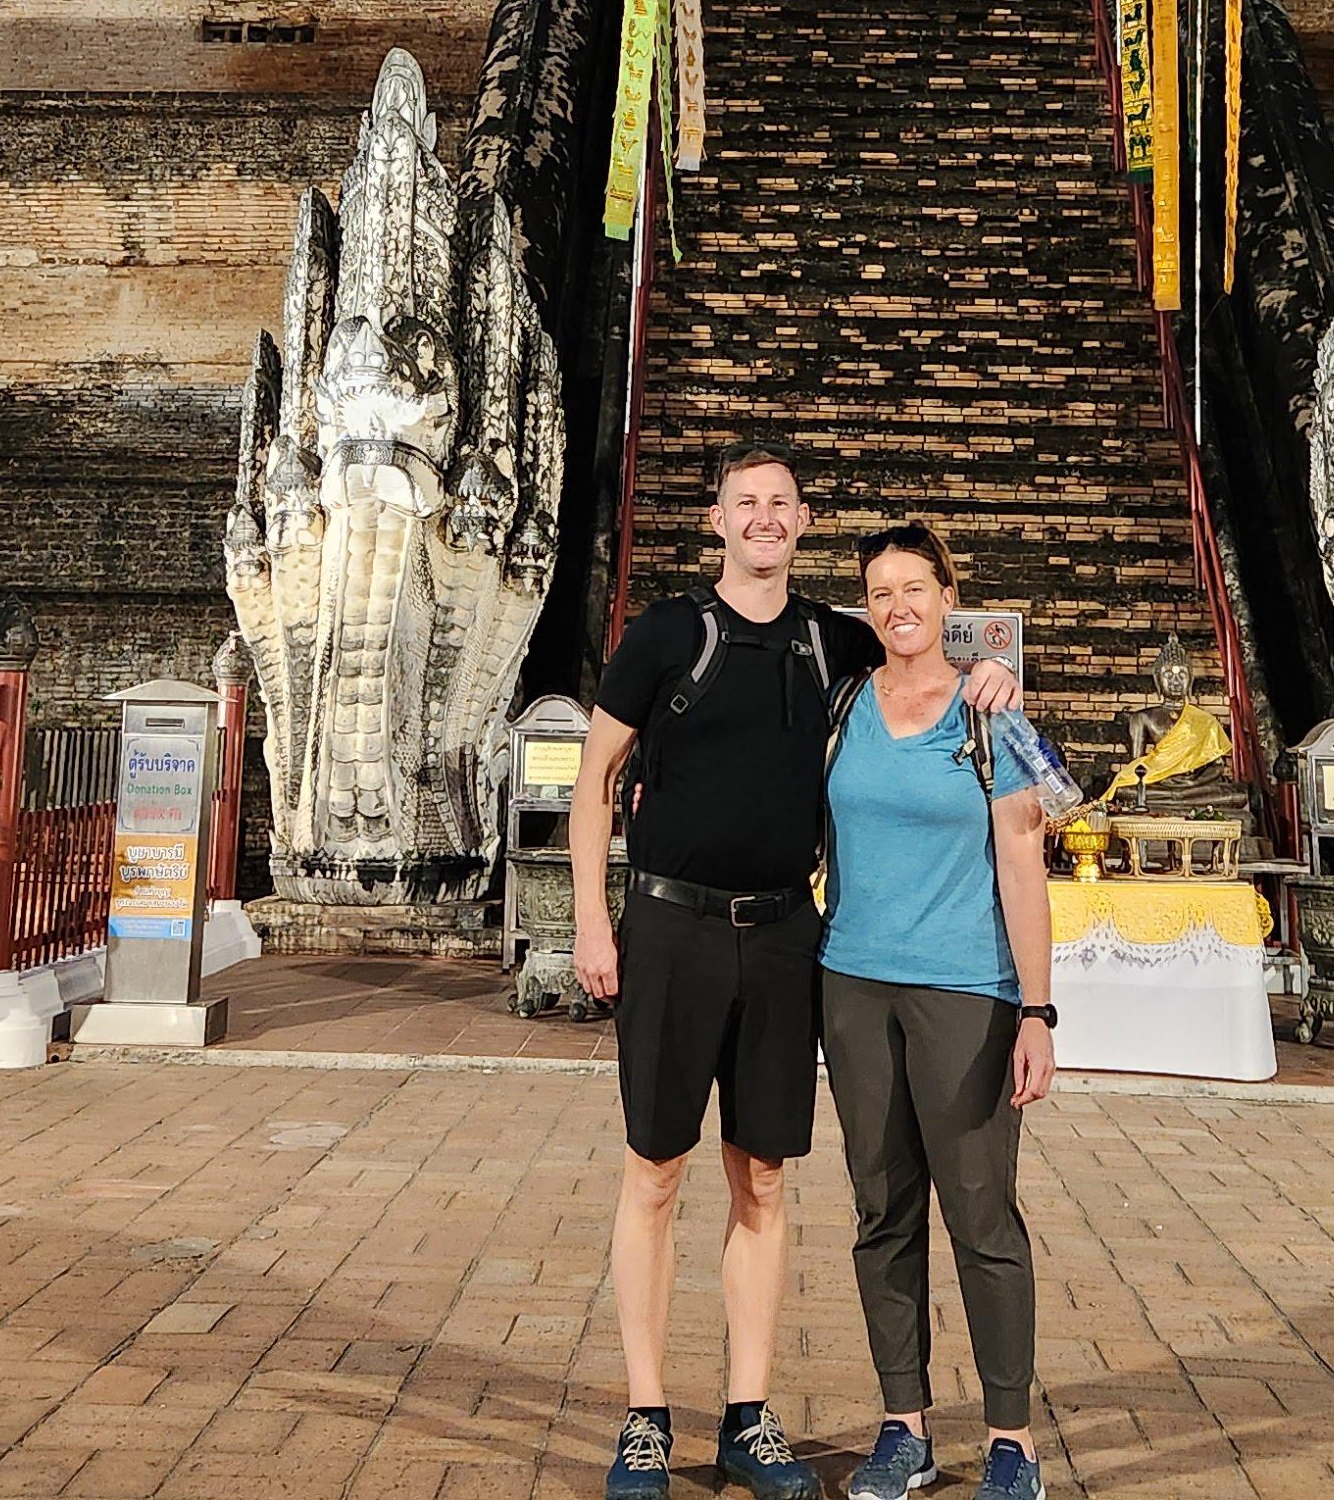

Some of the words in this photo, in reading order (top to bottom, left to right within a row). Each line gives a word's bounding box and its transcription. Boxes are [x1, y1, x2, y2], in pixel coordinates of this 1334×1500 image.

[128, 749, 195, 779] ตู้รับบริจาค
[127, 783, 170, 794] Donation
[174, 784, 192, 795] Box
